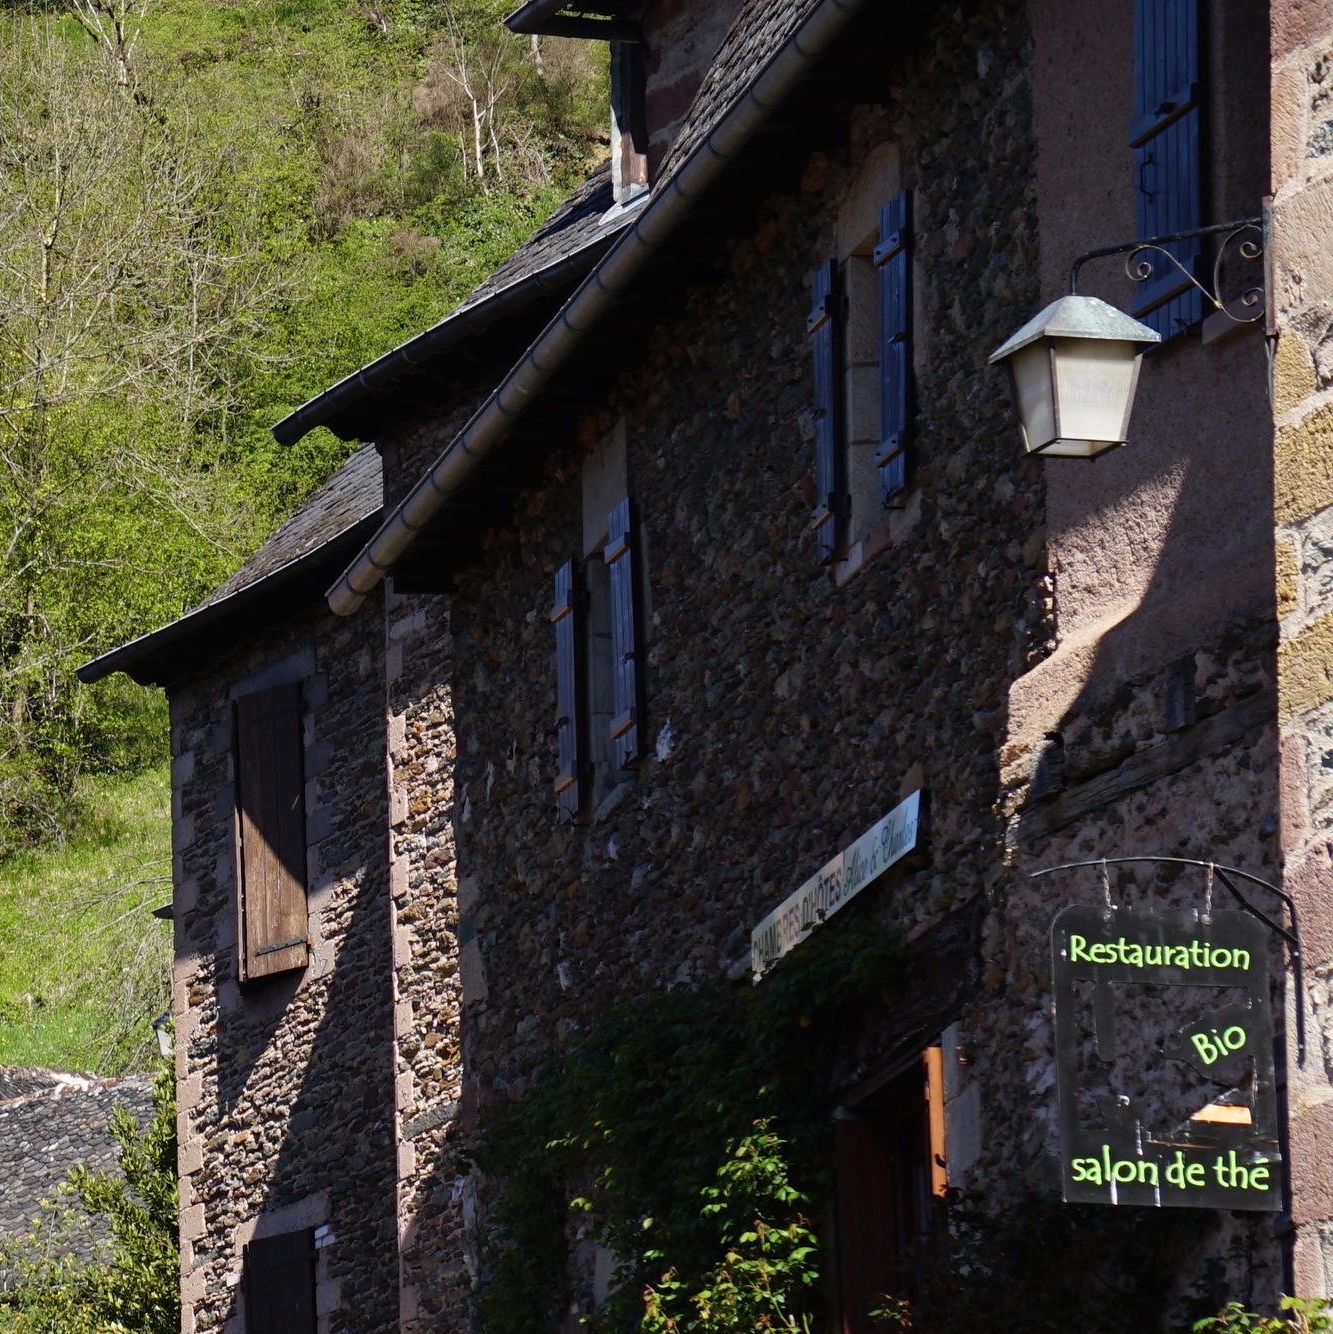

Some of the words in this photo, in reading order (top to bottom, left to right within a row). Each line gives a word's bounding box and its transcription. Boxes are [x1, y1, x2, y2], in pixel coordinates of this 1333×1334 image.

[753, 903, 800, 970] CHAMBRES
[802, 866, 842, 925] D'HÔTES
[843, 847, 868, 896] Alice
[869, 836, 882, 874] &
[881, 807, 914, 863] Charles
[1070, 934, 1250, 970] Restauration
[1191, 1026, 1246, 1065] Bio
[1071, 1144, 1158, 1185] salon
[1165, 1151, 1206, 1189] de
[1212, 1151, 1270, 1190] thé
